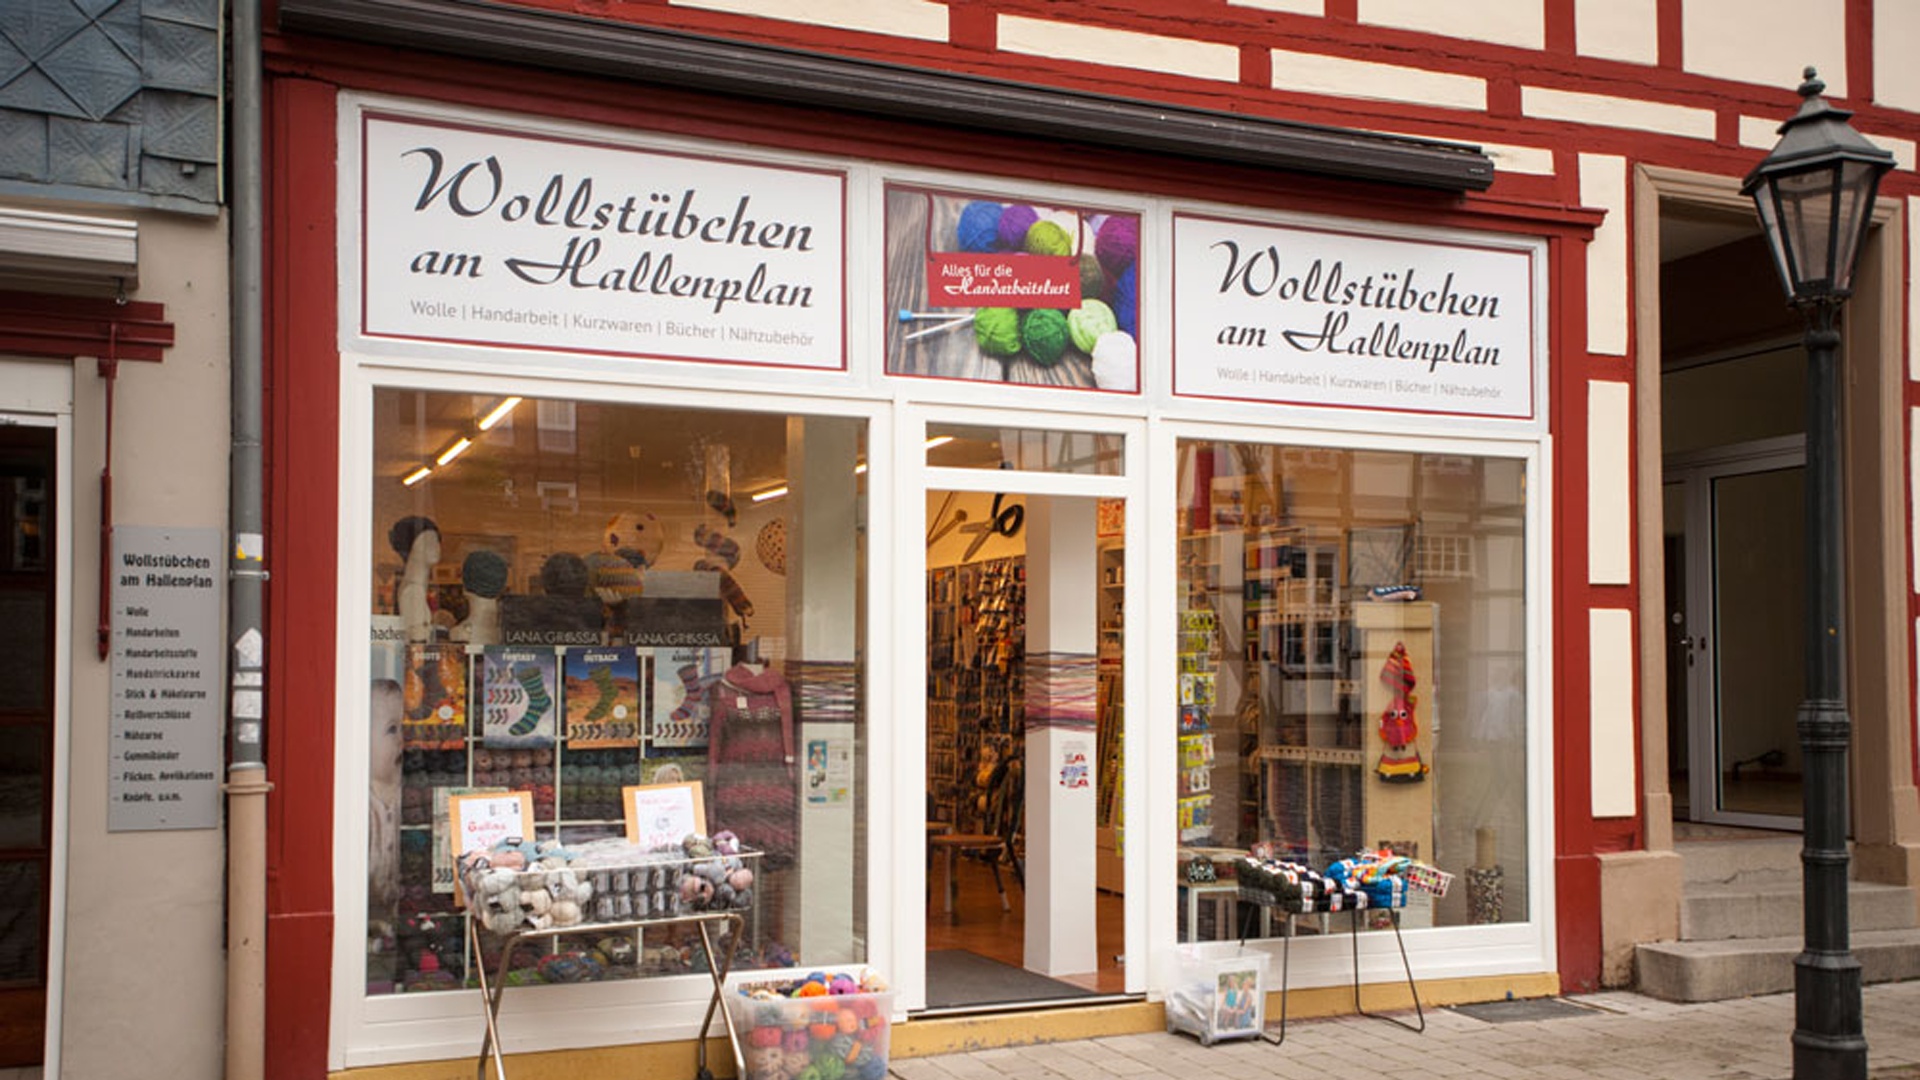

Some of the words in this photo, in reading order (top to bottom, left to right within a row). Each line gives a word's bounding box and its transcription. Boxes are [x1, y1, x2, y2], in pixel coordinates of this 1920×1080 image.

[401, 147, 814, 251] Wollstübchen
[410, 250, 484, 278] am
[504, 236, 813, 313] Hallenplan
[942, 264, 971, 278] Alles
[974, 264, 991, 277] für
[994, 265, 1012, 277] die
[1210, 240, 1500, 318] Wollstübchen
[944, 276, 1070, 295] Handarbeitslust
[410, 300, 457, 318] Wolle
[471, 305, 559, 327] Handarbeit
[572, 314, 653, 333] Kurzwaren
[666, 320, 716, 339] Bücher
[729, 327, 814, 347] Nähzubehör
[1217, 325, 1268, 347] am
[1282, 310, 1500, 373] Hallenplan
[1217, 367, 1250, 381] Wolle
[1259, 369, 1321, 386] Handarbeit
[1330, 376, 1387, 391] Kurzwaren
[1395, 379, 1431, 394] Bücher
[1440, 384, 1500, 399] Nähzubehör
[123, 553, 210, 569] Wollstübchen
[121, 576, 139, 586] am
[146, 574, 212, 588] Hallenplan
[126, 607, 149, 617] Wolle
[506, 631, 541, 643] LANA
[629, 633, 663, 645] LANA
